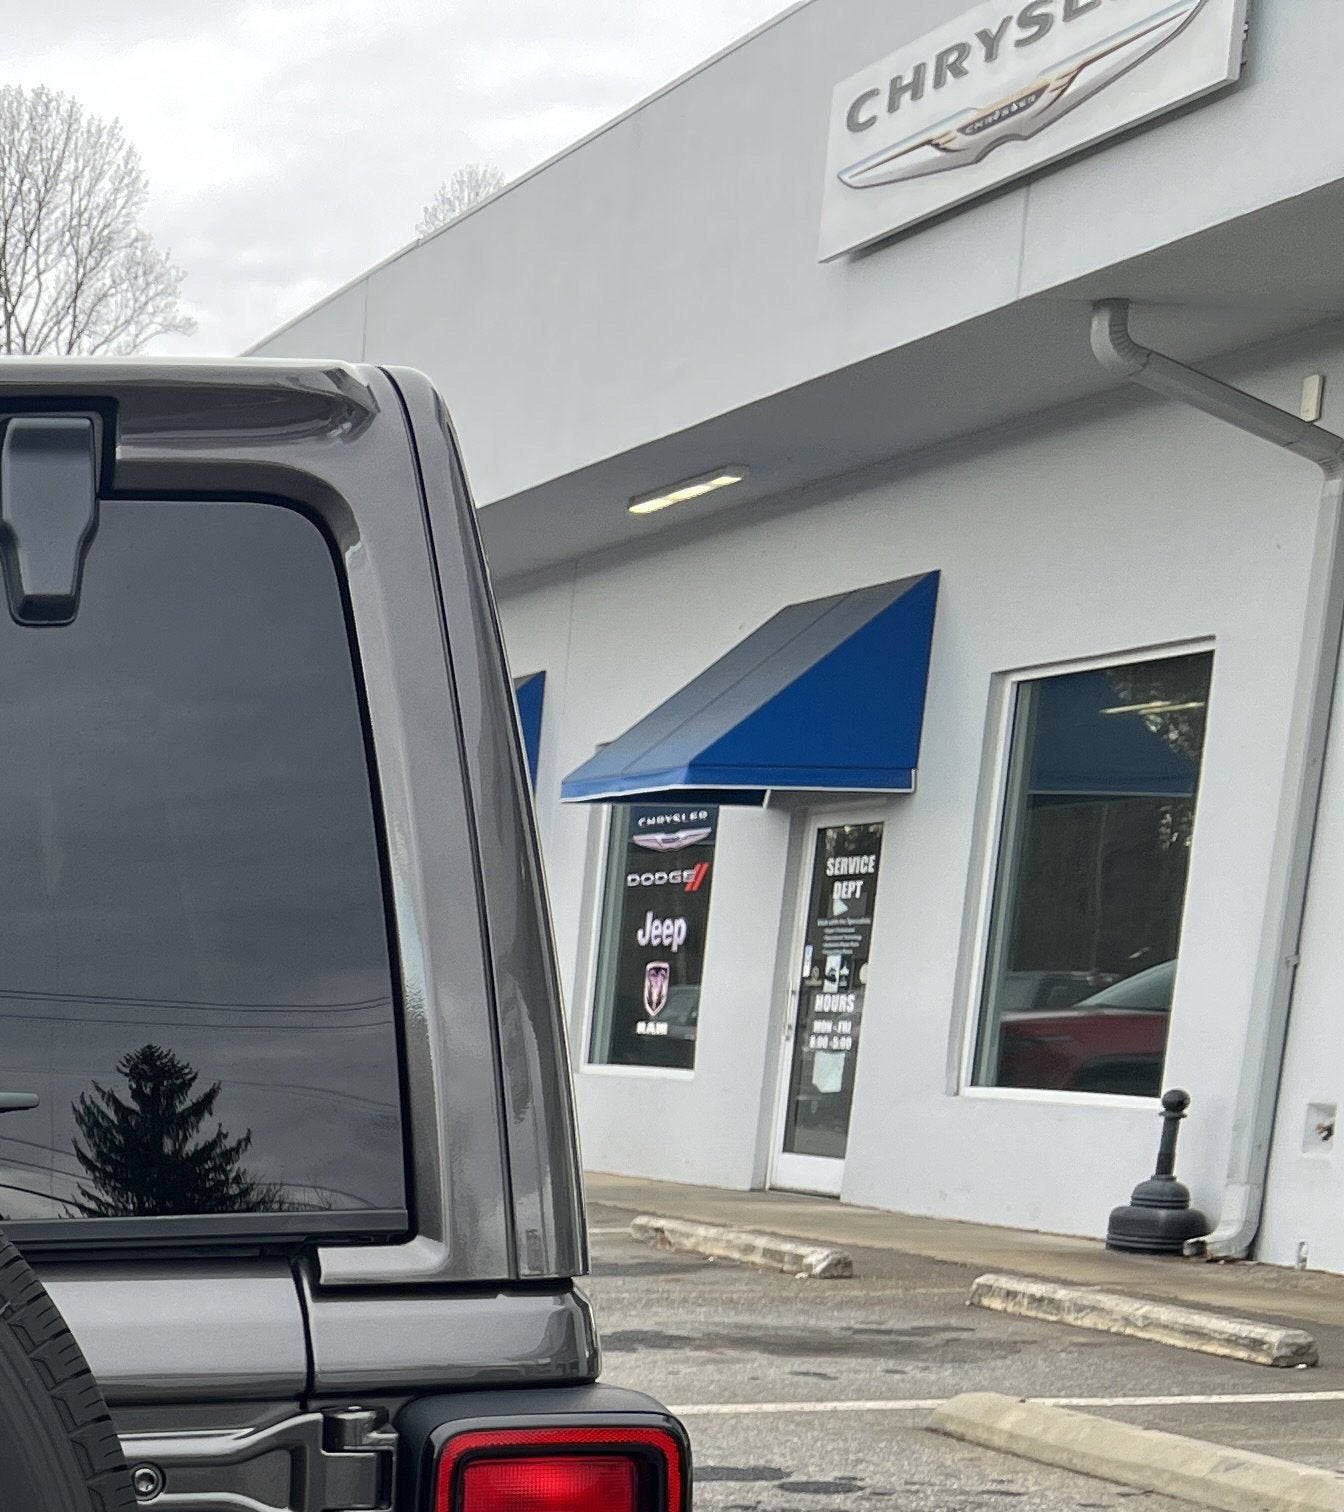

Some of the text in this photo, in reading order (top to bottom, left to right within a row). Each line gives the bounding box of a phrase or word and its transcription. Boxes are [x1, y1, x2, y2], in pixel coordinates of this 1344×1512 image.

[826, 854, 876, 877] SERVICE
[626, 868, 697, 887] DODGE
[833, 880, 864, 900] DEPT
[637, 911, 687, 953] Jeep
[815, 993, 855, 1013] HOURS
[636, 1021, 668, 1036] RAM
